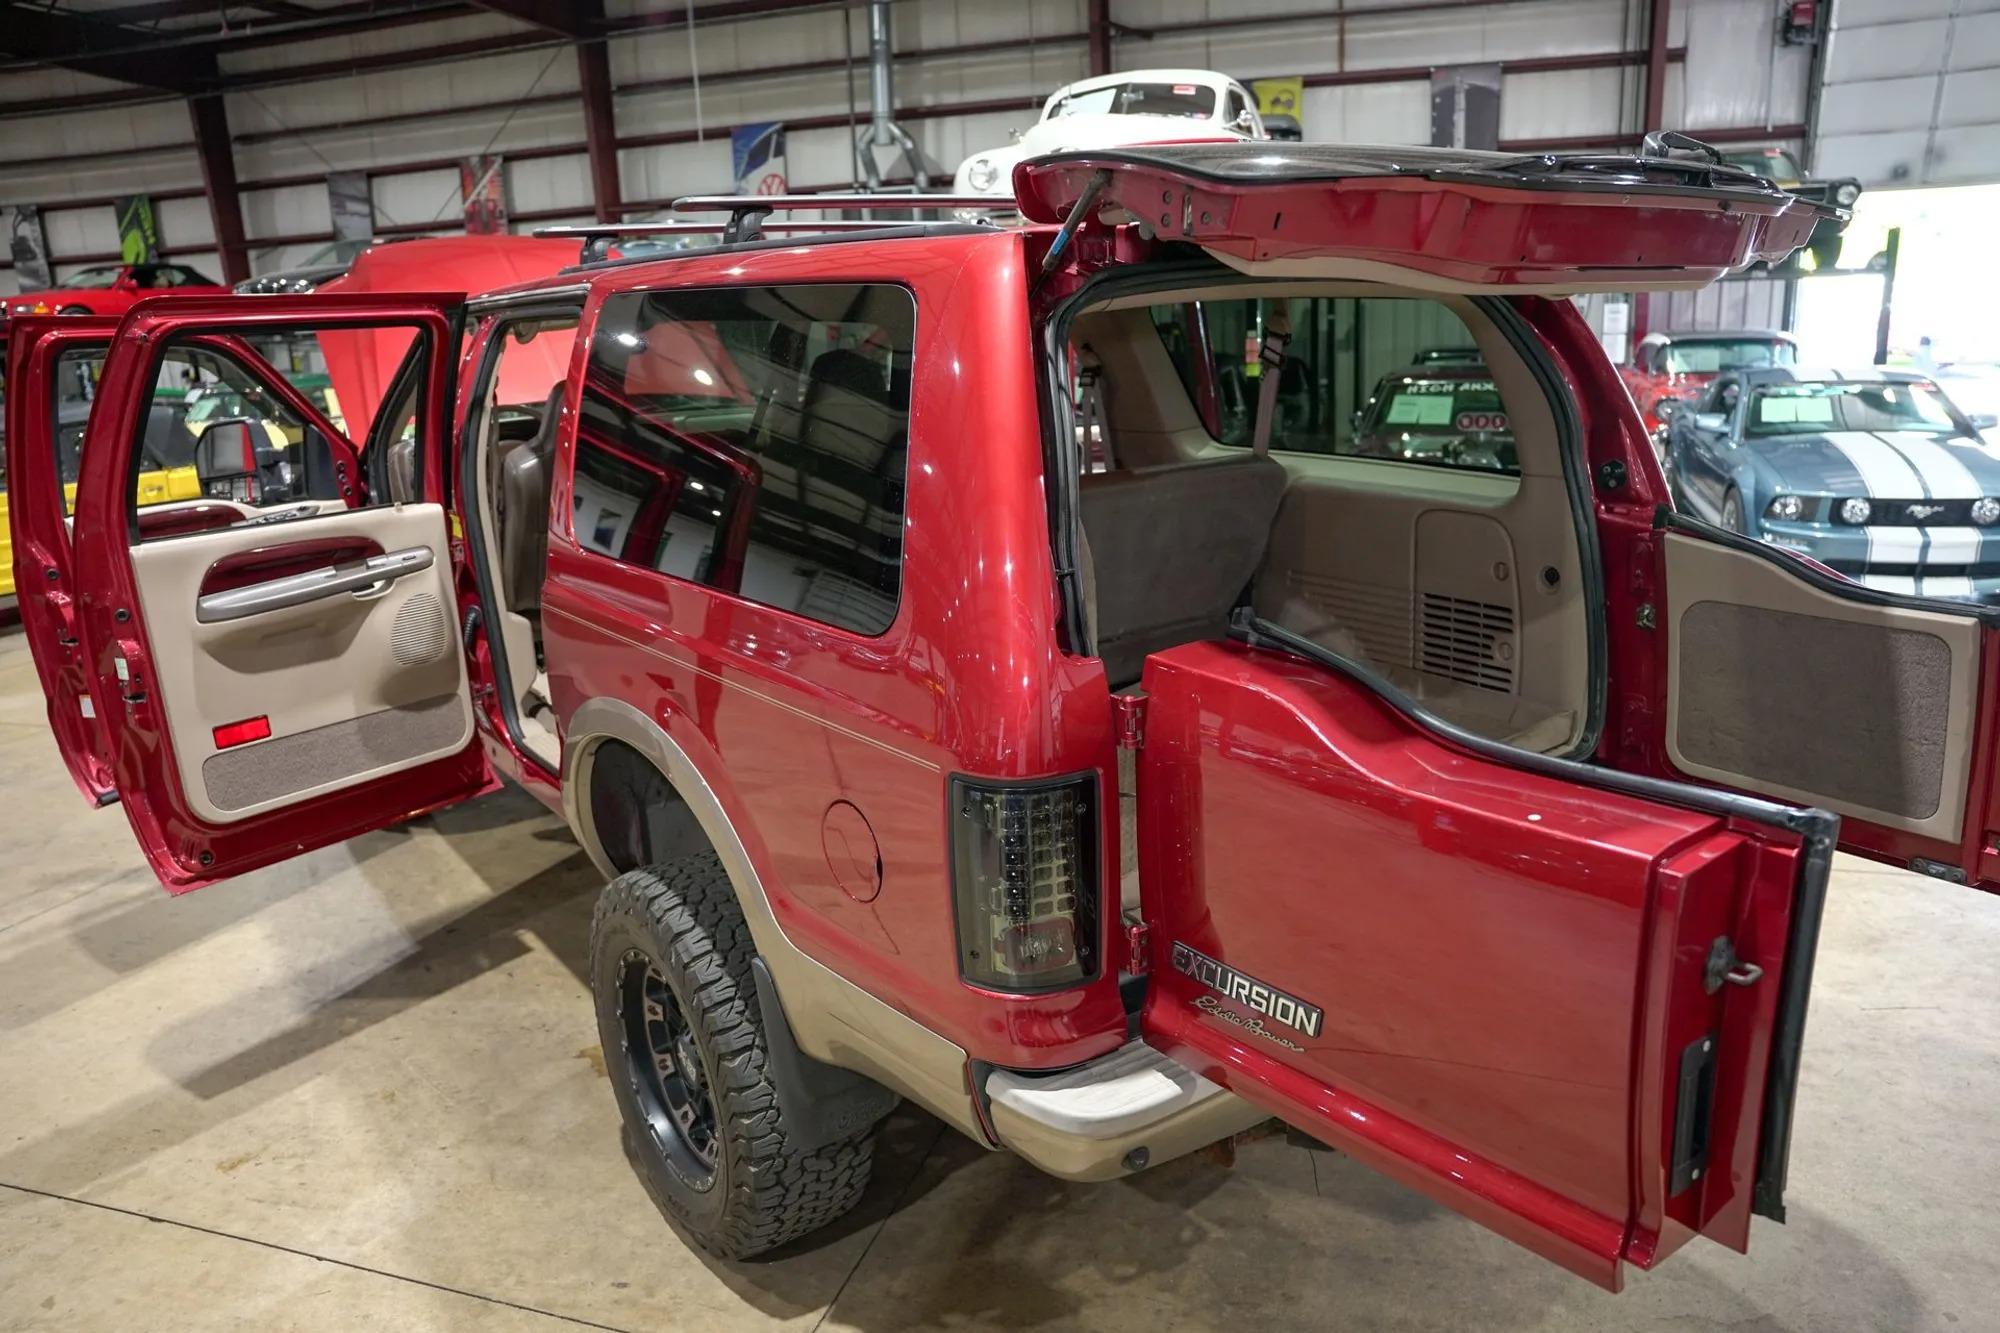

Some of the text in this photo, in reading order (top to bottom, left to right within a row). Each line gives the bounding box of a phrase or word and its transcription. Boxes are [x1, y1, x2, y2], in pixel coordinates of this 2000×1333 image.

[1172, 944, 1318, 1037] EXCURSION
[1191, 996, 1305, 1052] Eddie Bauer
